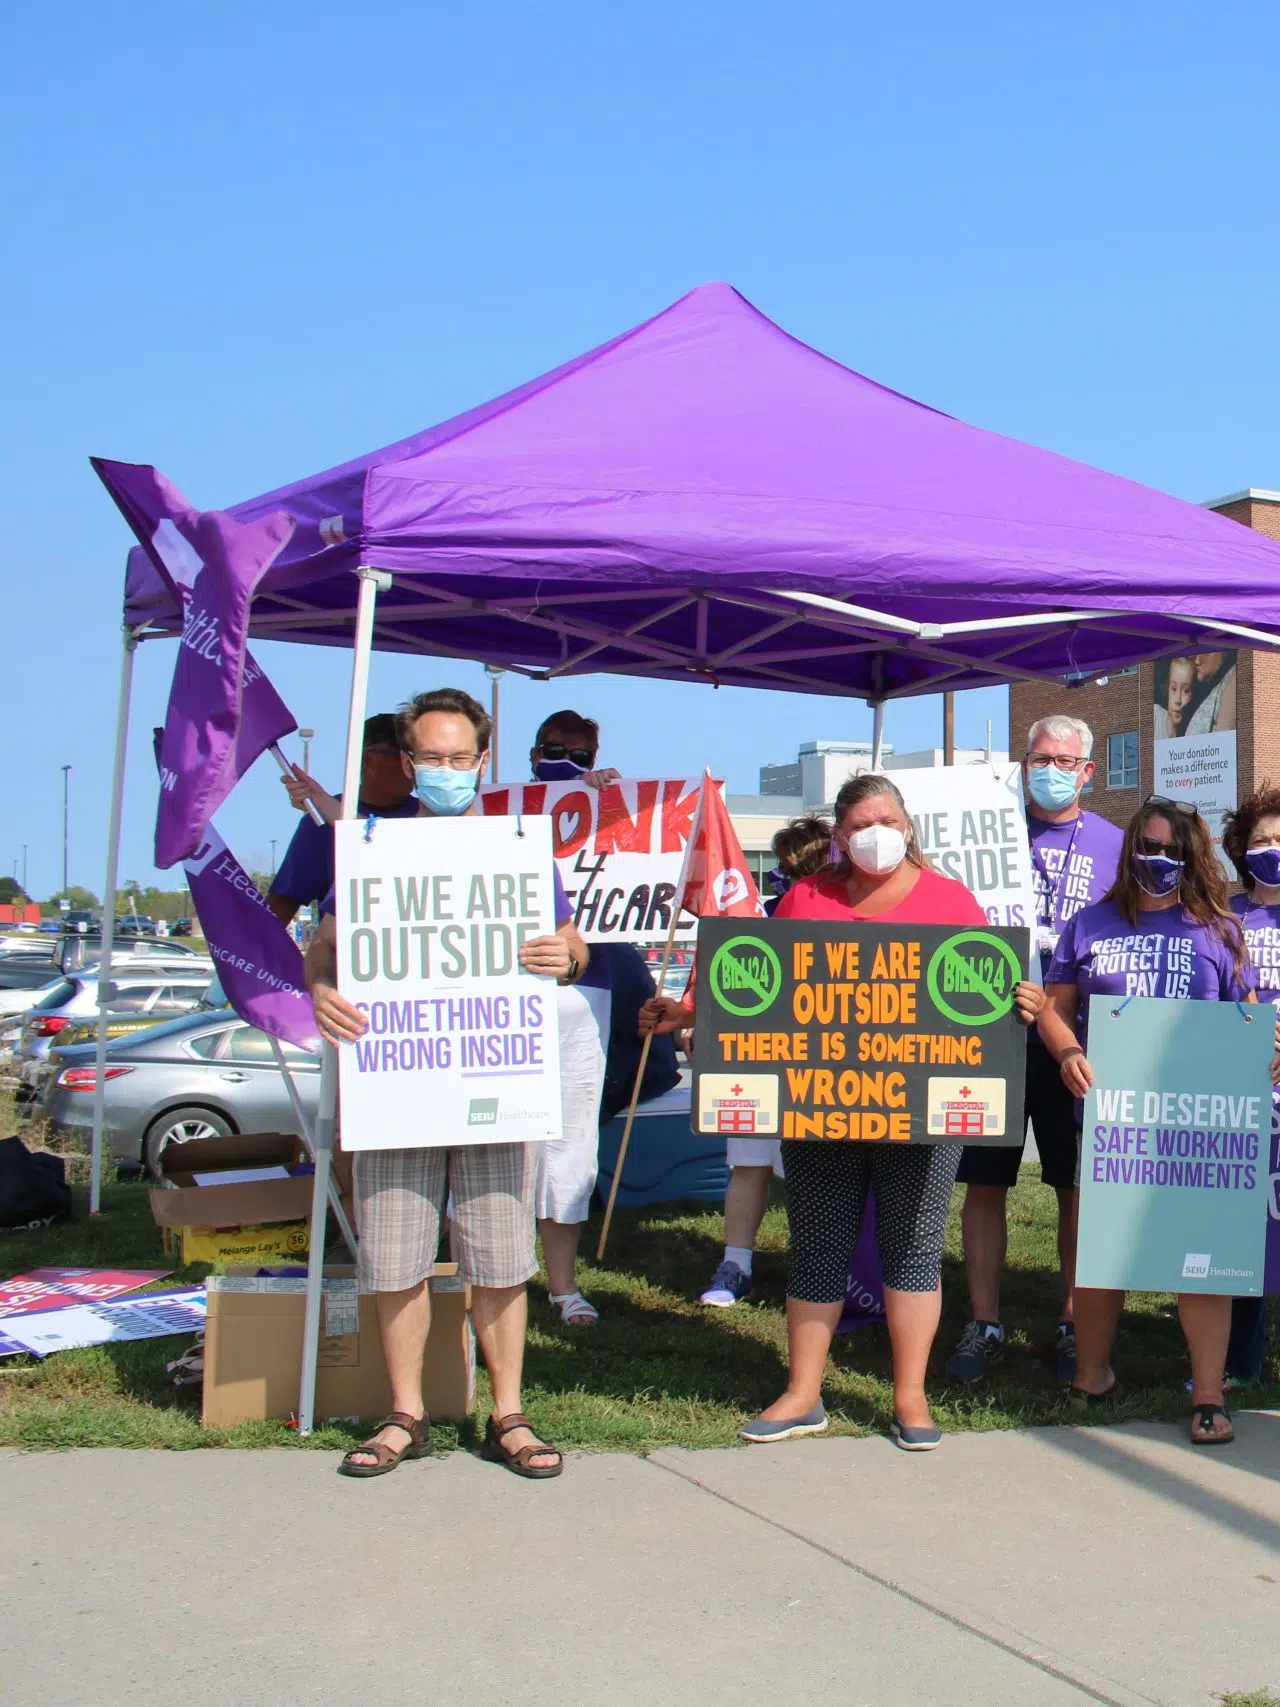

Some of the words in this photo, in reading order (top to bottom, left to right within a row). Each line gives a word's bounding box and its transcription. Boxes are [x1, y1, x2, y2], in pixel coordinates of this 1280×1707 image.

[1168, 750, 1186, 761] Your
[1186, 745, 1220, 759] donation
[1160, 765, 1184, 776] makes
[1184, 765, 1190, 773] a
[1190, 759, 1229, 773] difference
[1165, 778, 1174, 788] to
[1174, 778, 1193, 789] every
[1194, 773, 1224, 788] patient.
[960, 807, 1018, 847] ARE
[572, 850, 608, 898] 4
[1068, 853, 1095, 879] US.
[349, 877, 383, 924] IF
[394, 875, 454, 922] WE
[466, 872, 541, 920] ARE
[1065, 875, 1092, 901] US.
[1005, 903, 1025, 928] IS
[1090, 933, 1165, 956] RESPECT
[1167, 937, 1197, 956] US.
[793, 942, 814, 980] IF
[825, 942, 859, 980] WE
[871, 942, 921, 980] ARE
[1089, 952, 1163, 979] PROTECT
[1167, 952, 1196, 976] US.
[256, 969, 304, 1000] UNION
[1126, 972, 1160, 998] PAY
[1164, 972, 1191, 1000] US.
[519, 994, 544, 1029] IS
[793, 982, 917, 1025] OUTSIDE
[355, 1035, 452, 1074] WRONG
[460, 1032, 544, 1068] INSIDE
[718, 1031, 808, 1062] THERE
[821, 1032, 847, 1061] IS
[858, 1033, 982, 1066] SOMETHING
[786, 1068, 907, 1108] WRONG
[470, 1111, 496, 1122] SEIU
[719, 1099, 757, 1108] HOSPITAL
[946, 1101, 988, 1111] HOSPITAL
[1096, 1089, 1136, 1123] WE
[1143, 1091, 1261, 1130] DESERVE
[783, 1111, 911, 1141] INSIDE
[1093, 1125, 1150, 1156] SAFE
[1156, 1128, 1259, 1161] WORKING
[1093, 1157, 1257, 1191] ENVIRONMENTS
[218, 1245, 256, 1256] Mélange
[258, 1240, 281, 1254] Lay's
[291, 1234, 304, 1245] 36
[1185, 1265, 1206, 1274] SEIU
[1210, 1266, 1254, 1277] Healthcare
